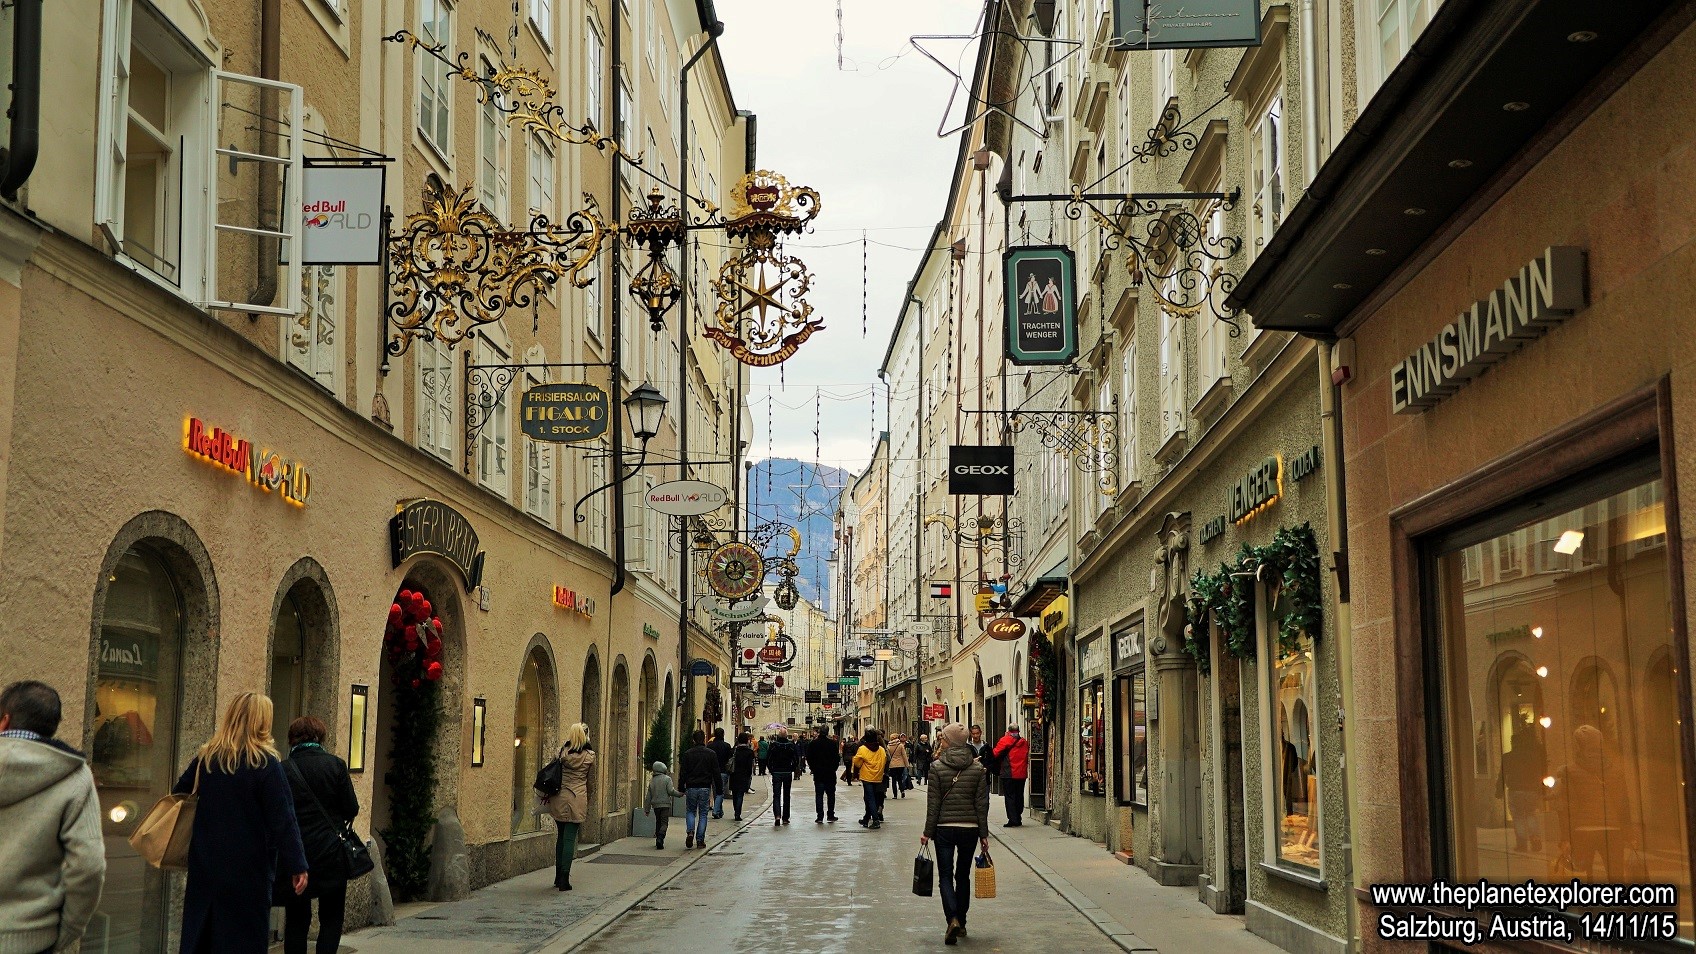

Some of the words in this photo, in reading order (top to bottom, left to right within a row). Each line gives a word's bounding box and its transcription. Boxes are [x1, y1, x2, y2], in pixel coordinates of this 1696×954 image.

[302, 201, 320, 212] ed
[321, 201, 345, 212] Bull
[1022, 322, 1061, 330] TRACHTEN
[1391, 246, 1558, 415] ENNSMANN
[1026, 331, 1057, 339] WENGER
[529, 392, 600, 401] FRISIERSALON
[525, 405, 604, 421] FIGARO
[539, 426, 546, 434] 1.
[551, 426, 590, 434] STOCK
[954, 465, 1009, 475] GEOX
[651, 494, 665, 502] Red
[665, 494, 680, 502] Bull
[681, 493, 721, 502] WORLD
[711, 606, 759, 619] Aschauer
[1117, 631, 1141, 660] GEOX
